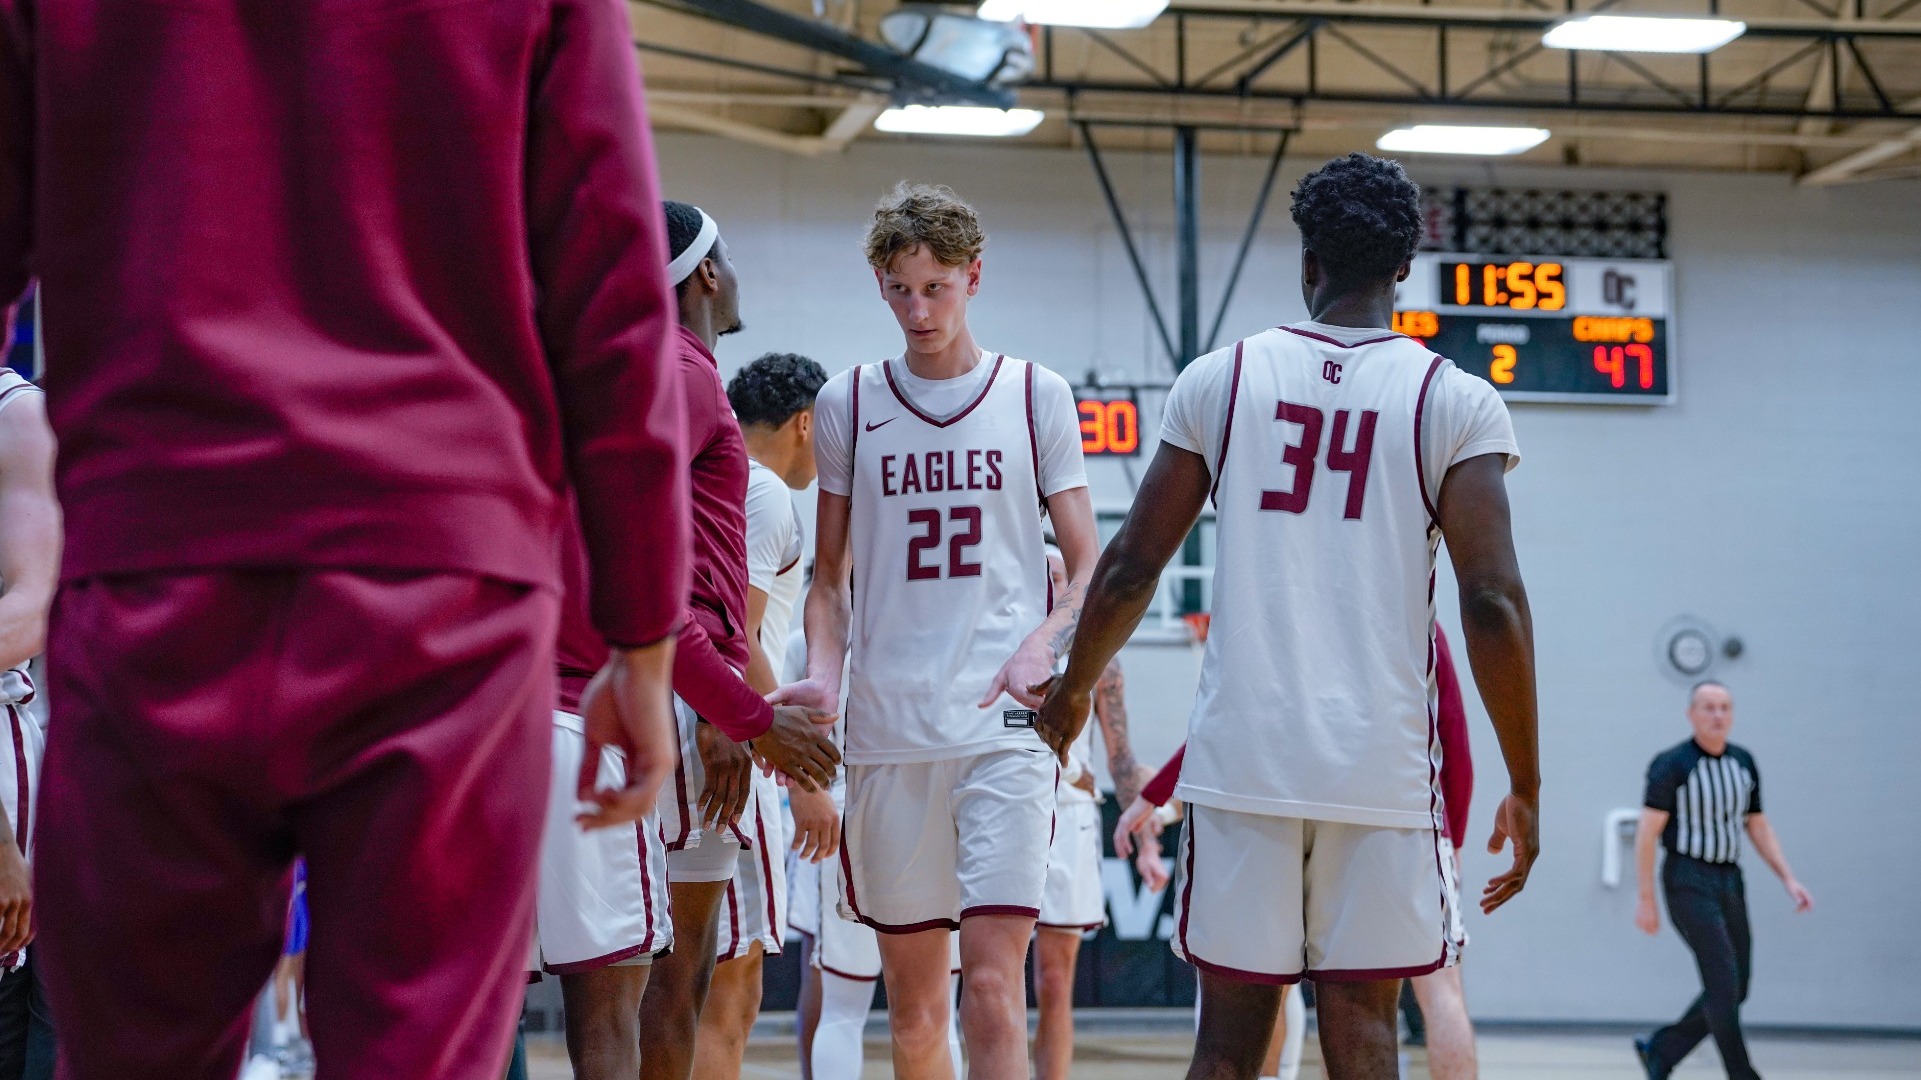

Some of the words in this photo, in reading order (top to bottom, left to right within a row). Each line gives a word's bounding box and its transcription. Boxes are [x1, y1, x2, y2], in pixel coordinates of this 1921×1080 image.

[1455, 262, 1566, 310] 11:55
[1603, 269, 1636, 310] OC
[1322, 360, 1342, 384] OC
[1490, 344, 1517, 384] 2
[1593, 343, 1654, 389] 47
[1078, 399, 1139, 454] 30
[881, 449, 1004, 498] EAGLES
[1258, 400, 1381, 522] 34
[906, 505, 983, 582] 22
